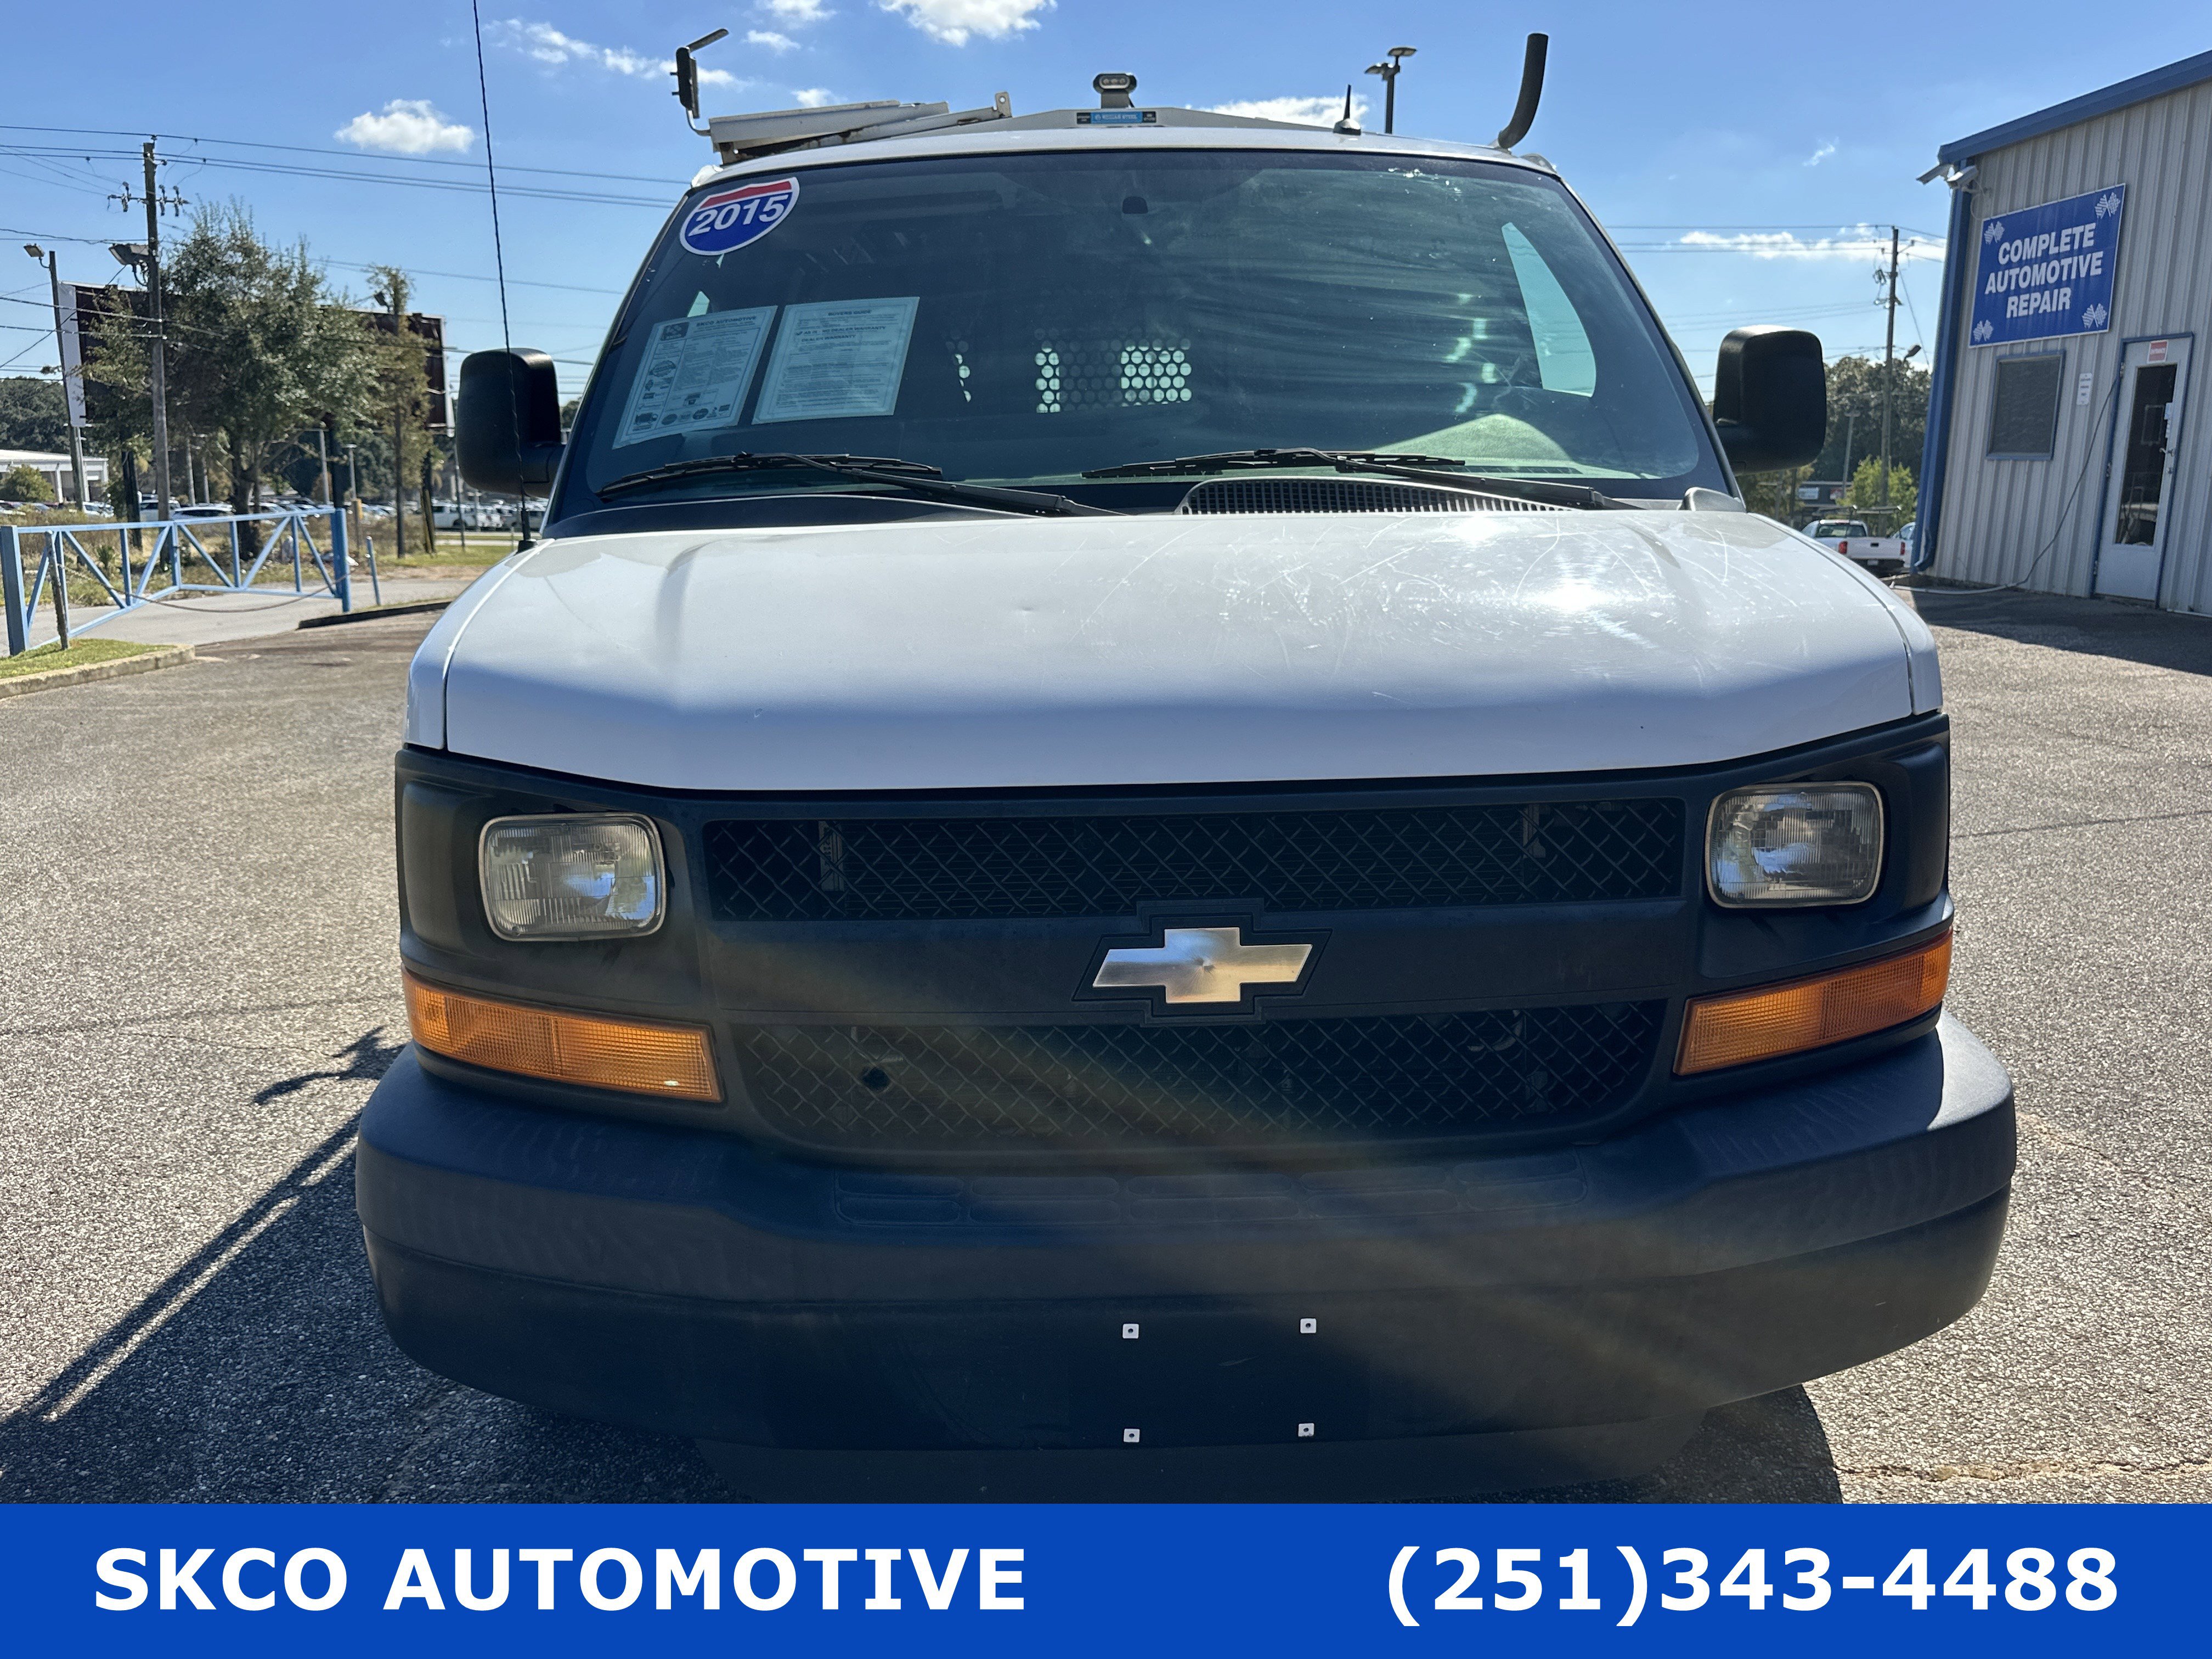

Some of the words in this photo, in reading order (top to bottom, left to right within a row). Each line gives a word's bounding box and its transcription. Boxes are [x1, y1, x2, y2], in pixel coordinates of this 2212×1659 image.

[688, 195, 789, 236] 2015
[1998, 222, 2096, 264] COMPLETE
[1984, 251, 2103, 295] AUTOMOTIVE
[2006, 287, 2072, 318] REPAIR
